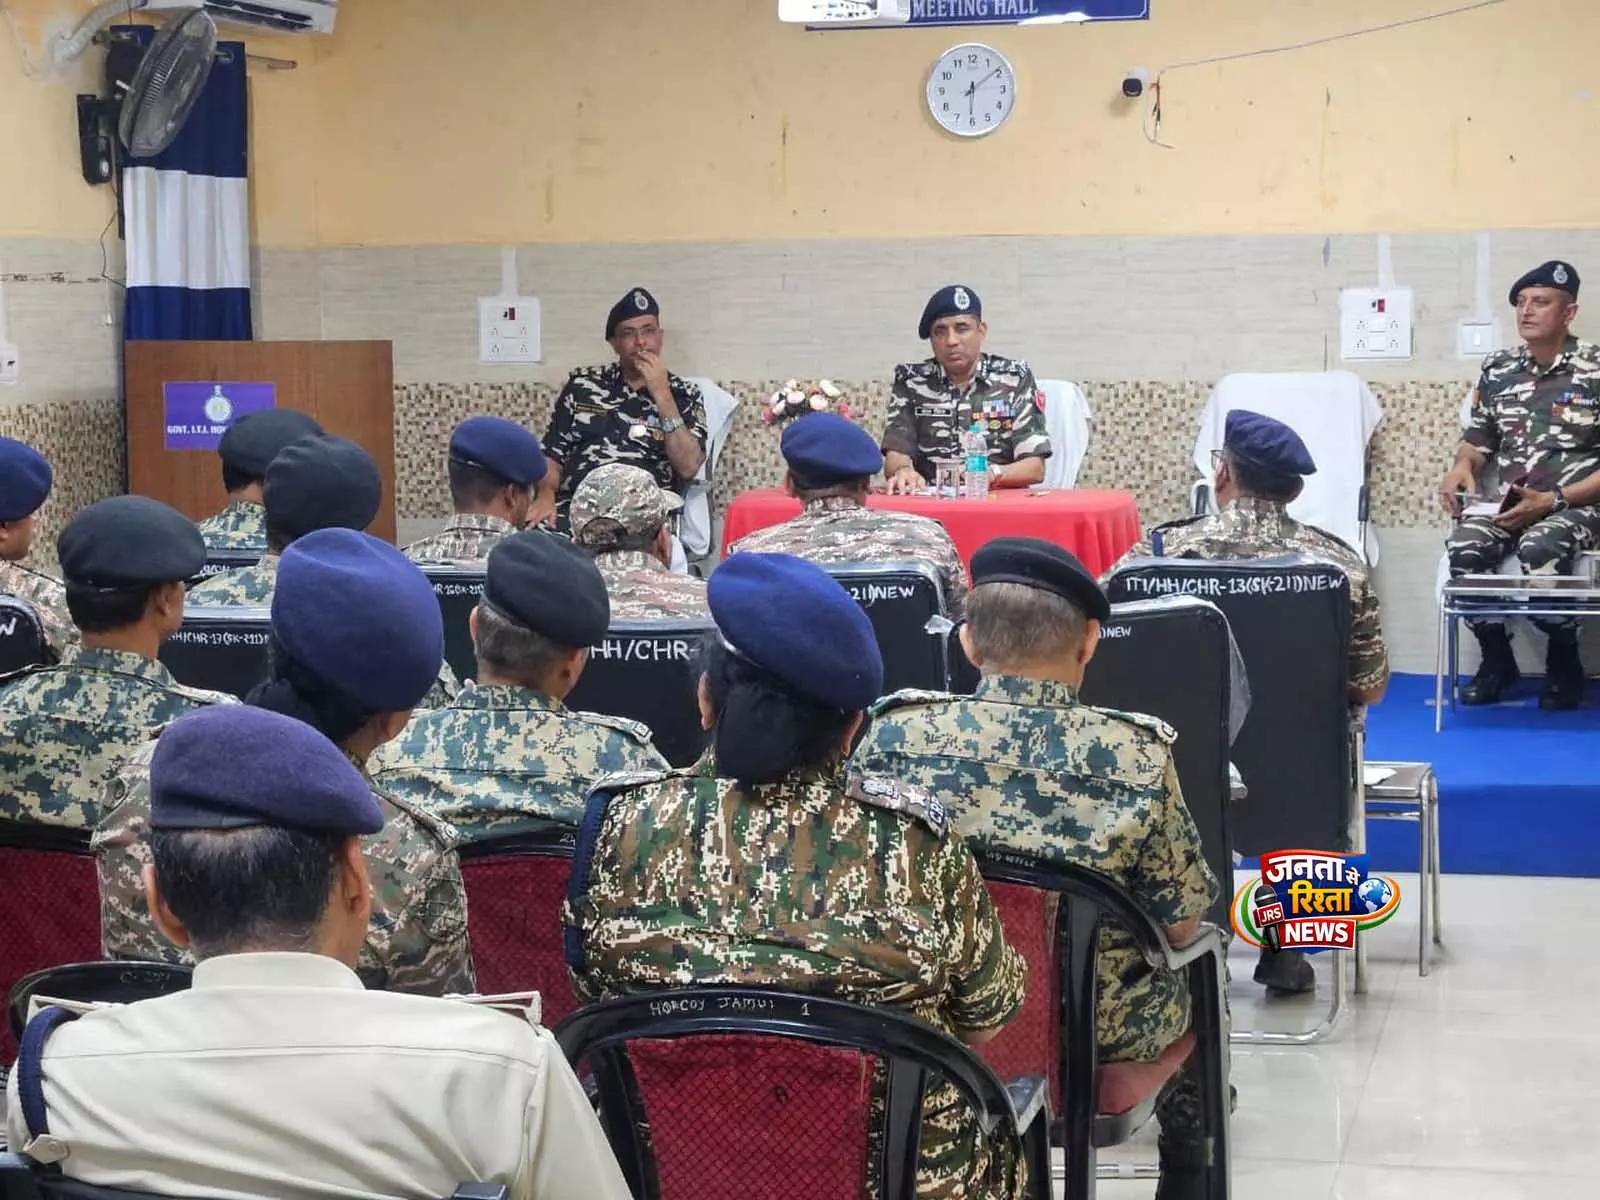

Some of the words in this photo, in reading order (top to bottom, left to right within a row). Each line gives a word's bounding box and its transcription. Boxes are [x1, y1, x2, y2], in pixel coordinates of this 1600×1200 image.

[912, 0, 988, 18] MEETING
[994, 0, 1039, 15] HALL
[953, 59, 962, 69] 11
[967, 54, 978, 64] 12
[942, 71, 952, 81] 10
[938, 87, 945, 96] 9
[1000, 85, 1006, 94] 3
[969, 117, 976, 127] 6
[984, 113, 991, 122] 5
